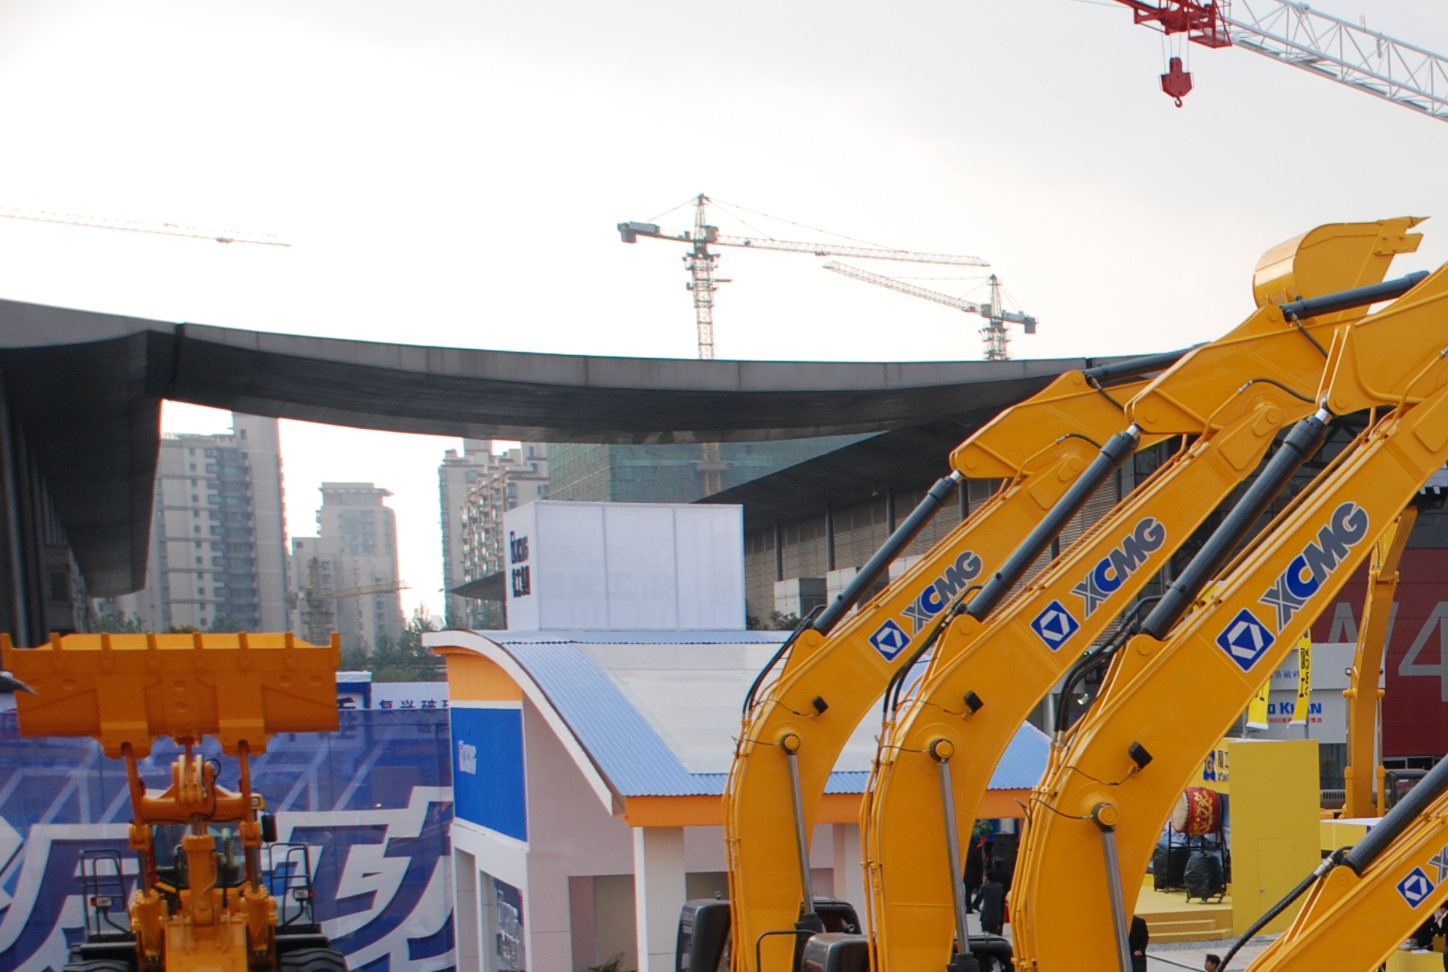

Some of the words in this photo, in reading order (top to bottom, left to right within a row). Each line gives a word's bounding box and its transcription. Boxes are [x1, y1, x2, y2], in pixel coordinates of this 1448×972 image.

[900, 550, 984, 637] XCMG
[1070, 517, 1167, 620] XCMG
[1258, 501, 1369, 635] XCMG
